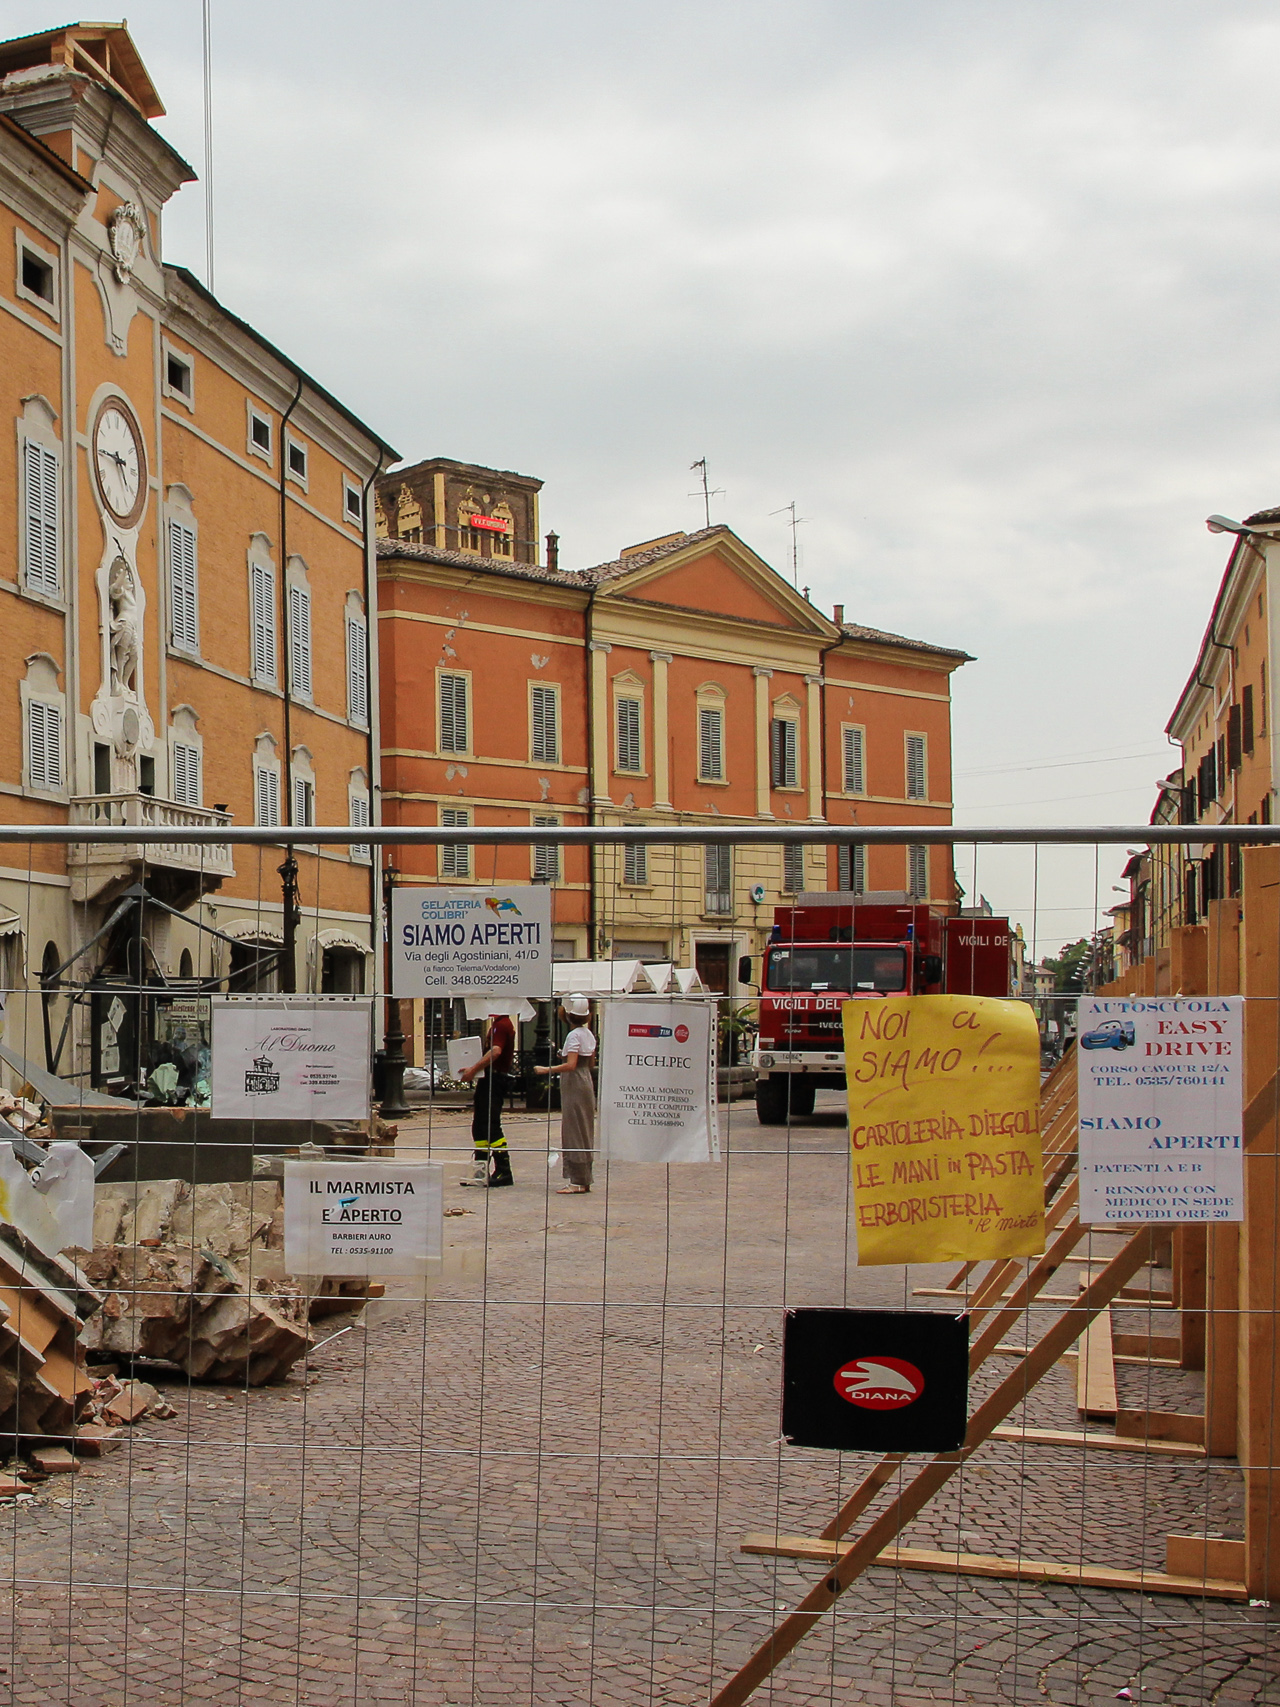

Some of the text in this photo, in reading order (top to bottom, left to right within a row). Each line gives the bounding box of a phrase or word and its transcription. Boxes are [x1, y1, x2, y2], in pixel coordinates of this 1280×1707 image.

[421, 900, 482, 910] GELATERIA
[421, 910, 469, 920] COLIBRI'
[403, 922, 541, 947] SIAMO APERTI
[958, 935, 989, 946] VIGILI
[404, 951, 421, 961] Via
[424, 951, 450, 963] degli
[452, 950, 512, 963] Agostiniani,
[514, 949, 539, 960] 41/D
[423, 965, 431, 973] (a
[456, 964, 520, 973] Telema/Vodafone)
[425, 974, 519, 986] Cell. 348.0522245
[772, 999, 841, 1010] VIGILI DEL
[1089, 1001, 1231, 1014] AUTOSCUOLA
[859, 1005, 911, 1041] NOI
[1157, 1020, 1228, 1035] EASY
[278, 1033, 336, 1052] Duomo
[1145, 1041, 1232, 1056] DRIVE
[625, 1054, 692, 1069] TECH.PEC
[854, 1047, 962, 1091] SIAMO
[1090, 1063, 1230, 1074] CORSO CAVOUR 12/A
[1094, 1075, 1226, 1087] TEL. 0535/760141
[659, 1087, 694, 1095] MOMENTO
[624, 1094, 666, 1102] TRASFERITI
[637, 1102, 657, 1110] BYTE
[658, 1104, 698, 1112] COMPUTER"
[1080, 1116, 1162, 1130] SIAMO
[1148, 1135, 1241, 1149] APERTI
[856, 1163, 885, 1189] LE
[892, 1153, 940, 1184] MANI
[965, 1150, 1035, 1181] PASTA
[1094, 1163, 1202, 1173] PATENTI A E B
[310, 1181, 415, 1195] IL MARMISTA
[1105, 1185, 1217, 1195] RINNOVO CON
[1105, 1197, 1234, 1207] MEDICO IN SEDE
[339, 1208, 402, 1222] APERTO
[858, 1192, 1004, 1227] ERBORISTERIA
[1105, 1209, 1229, 1218] GIOVEDI ORE 20
[369, 1233, 392, 1241] AURO
[331, 1247, 343, 1255] TEL
[349, 1247, 394, 1255] 0535-91100
[851, 1391, 912, 1401] DIANA
